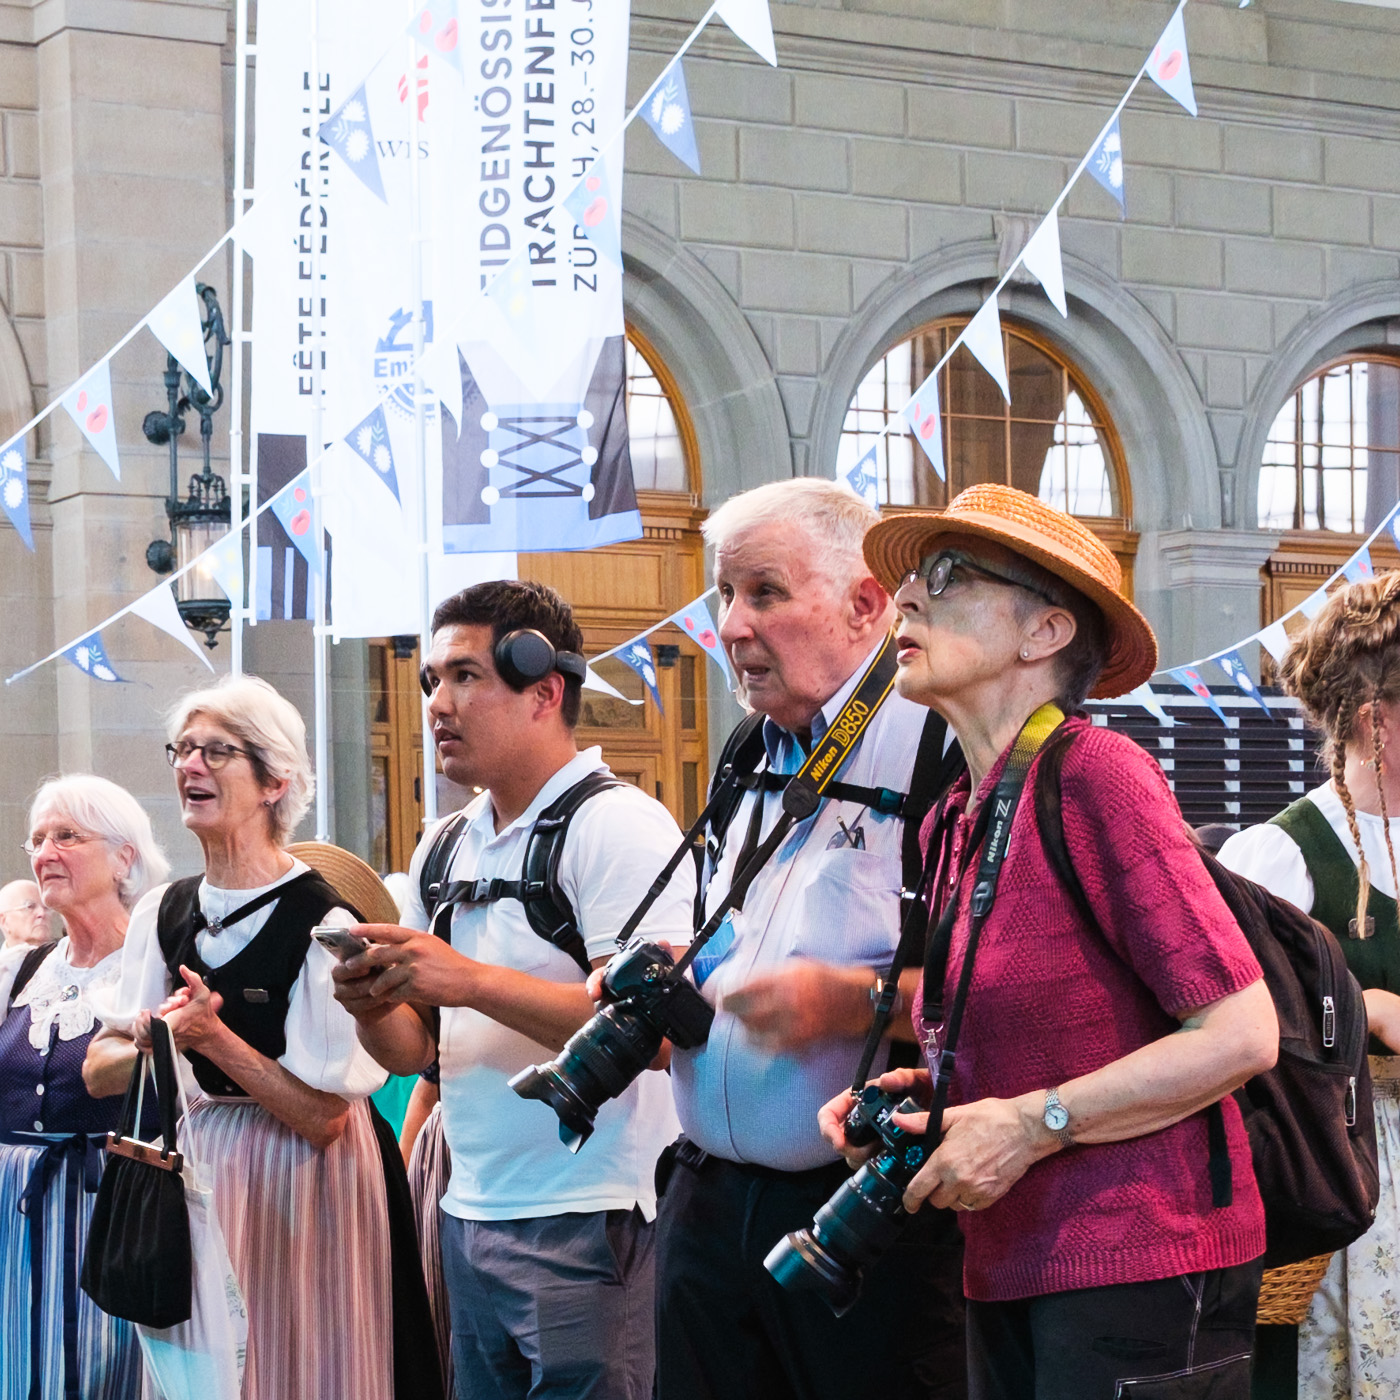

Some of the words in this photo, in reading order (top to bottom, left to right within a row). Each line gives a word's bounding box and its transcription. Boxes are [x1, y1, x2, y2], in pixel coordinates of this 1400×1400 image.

[567, 146, 600, 292] ZÜH,
[293, 298, 326, 395] FÊTE
[810, 745, 838, 782] Nikon
[831, 699, 870, 748] D850
[986, 820, 1004, 863] Nikon
